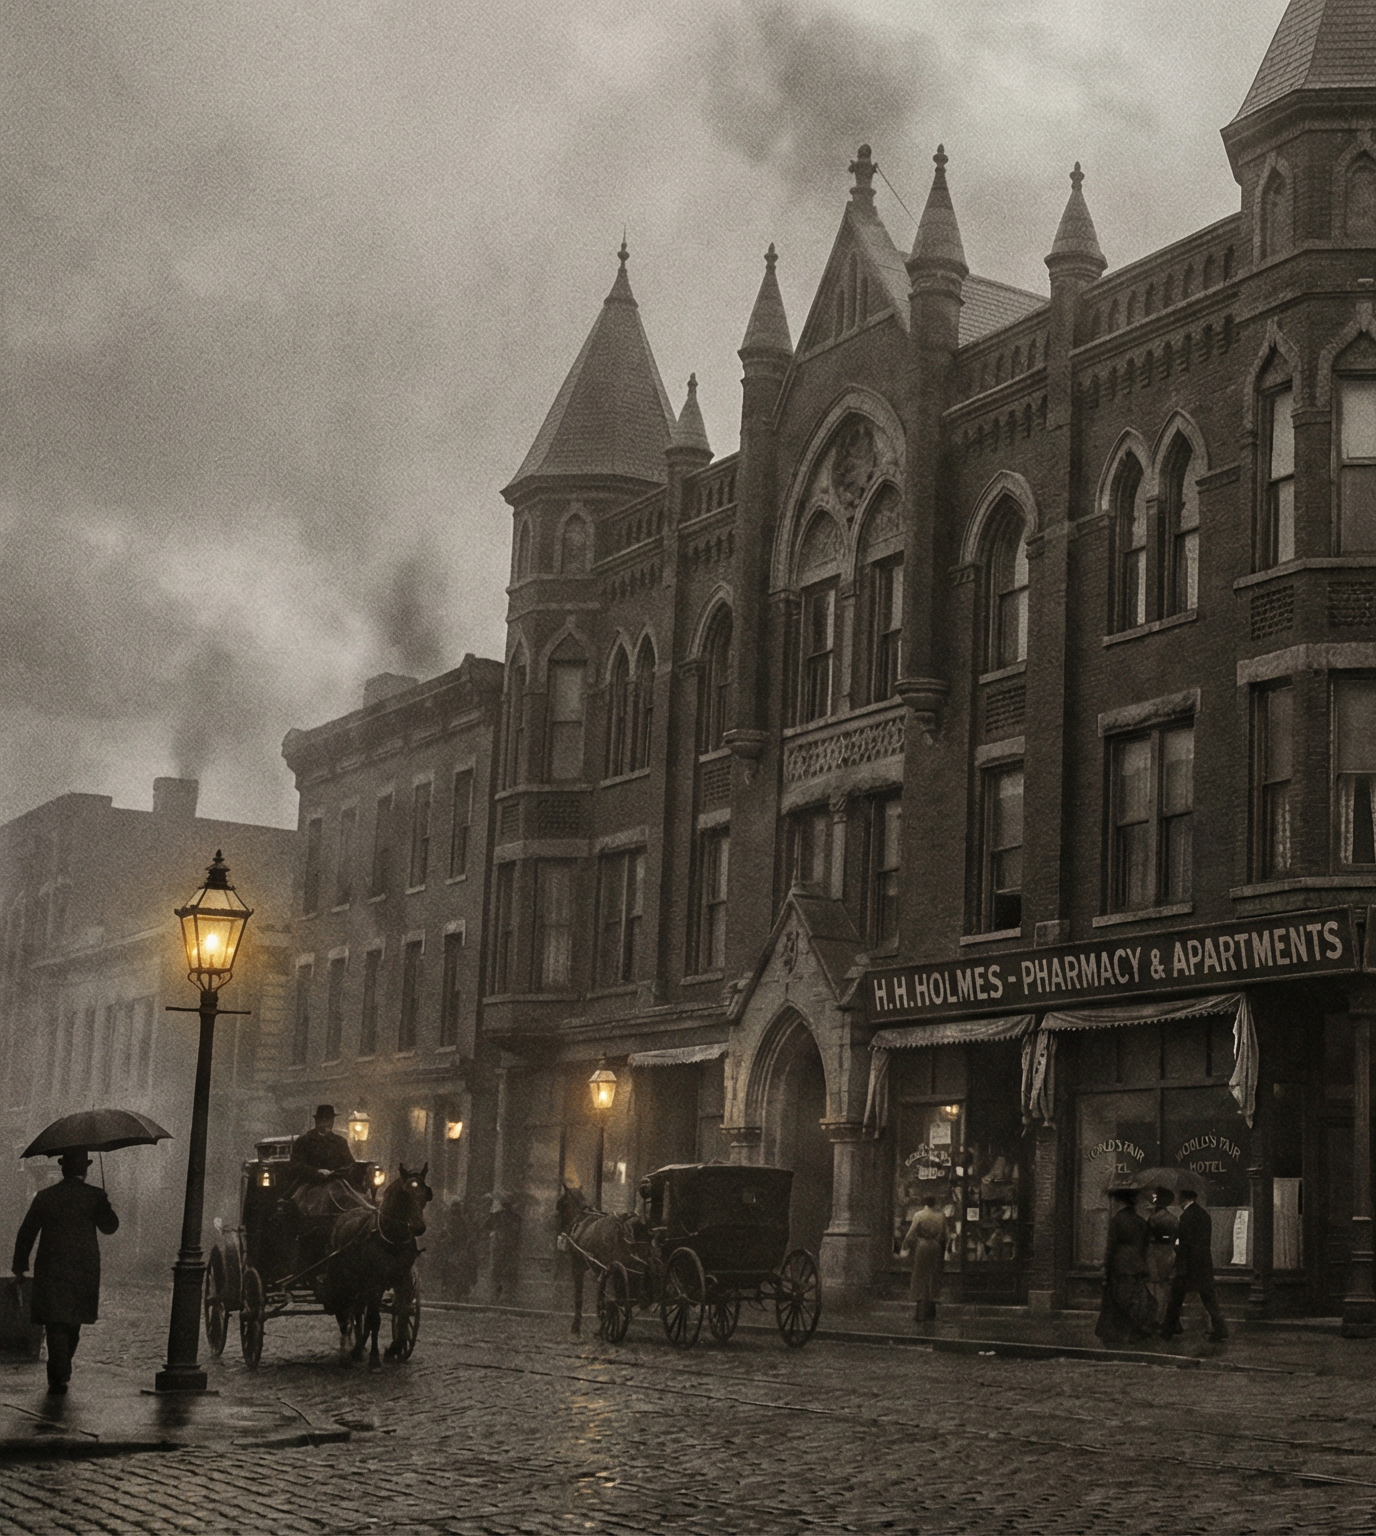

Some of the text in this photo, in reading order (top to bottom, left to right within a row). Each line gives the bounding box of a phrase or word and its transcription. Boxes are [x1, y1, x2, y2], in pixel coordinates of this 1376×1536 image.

[1021, 946, 1142, 995] PHARMACY
[1150, 948, 1166, 980] &
[1173, 920, 1343, 978] APARTMENTS
[1189, 1160, 1227, 1173] HOTEL
